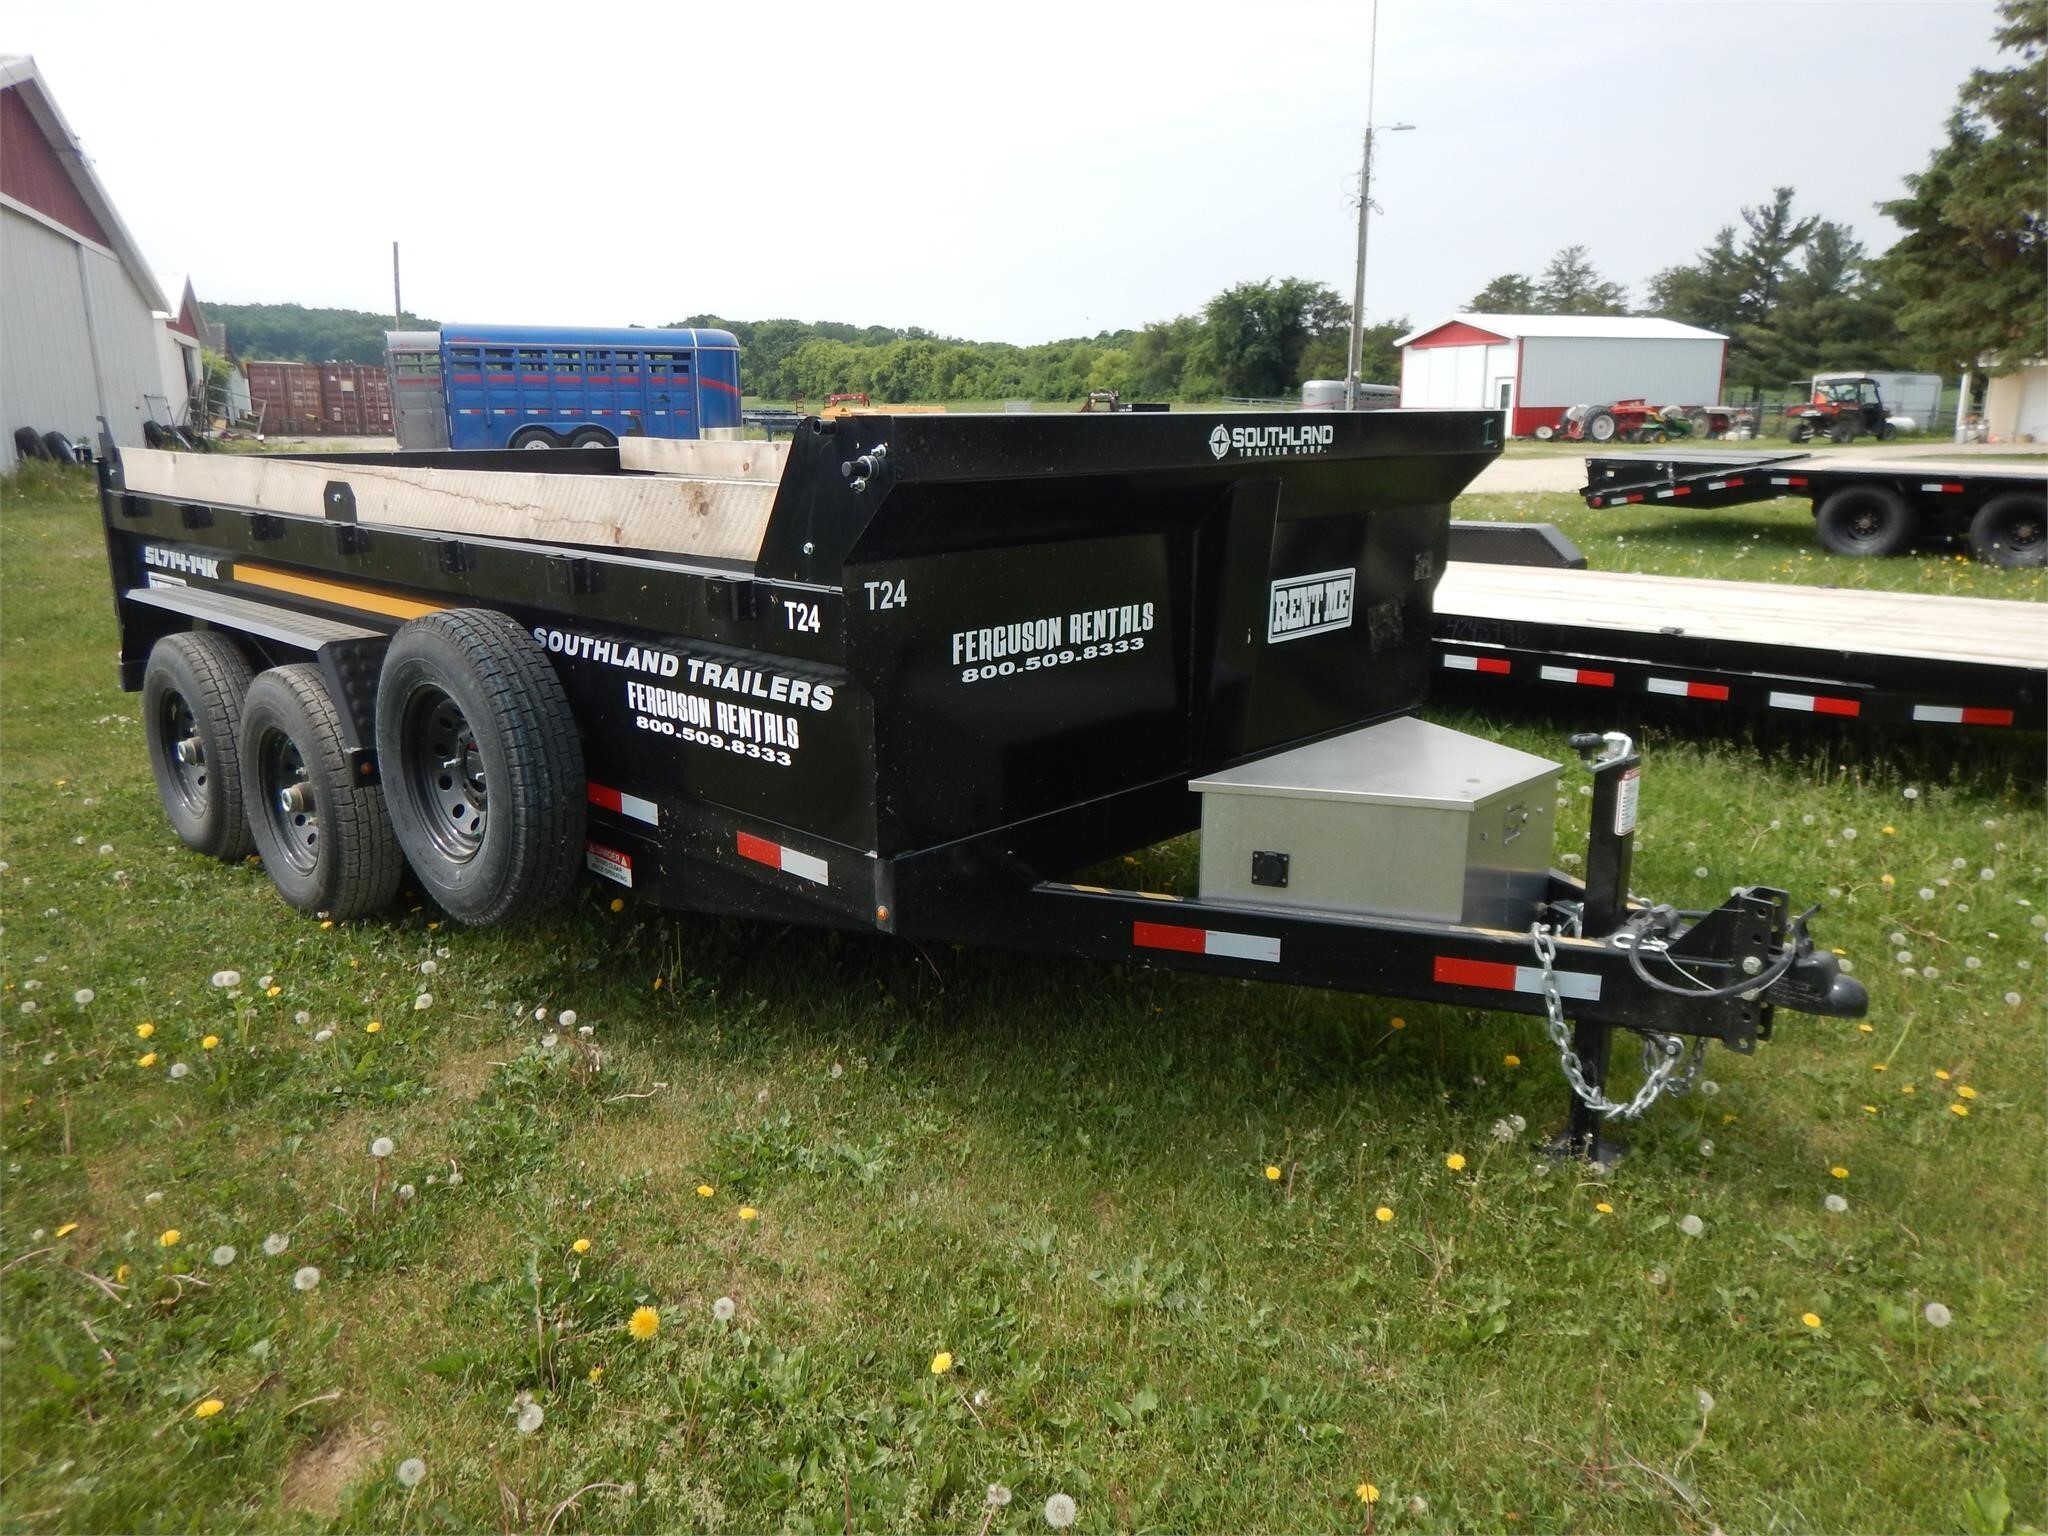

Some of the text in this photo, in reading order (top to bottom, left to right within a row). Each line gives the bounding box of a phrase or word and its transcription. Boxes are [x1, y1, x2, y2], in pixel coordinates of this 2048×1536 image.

[1231, 425, 1334, 449] SOUTHLAND
[1239, 445, 1327, 458] TRAILER CORP.
[144, 545, 219, 580] SL714-14K
[783, 600, 821, 634] T24
[863, 579, 908, 611] T24
[1273, 579, 1351, 633] RENT ME
[952, 602, 1154, 666] FERGUSON RENTALS
[533, 627, 835, 712] SOUTHLAND TRAILERS
[961, 637, 1145, 684] 800.509.8333
[626, 681, 800, 750] FERGUSON RENTALS
[635, 715, 792, 767] 800.509.8333
